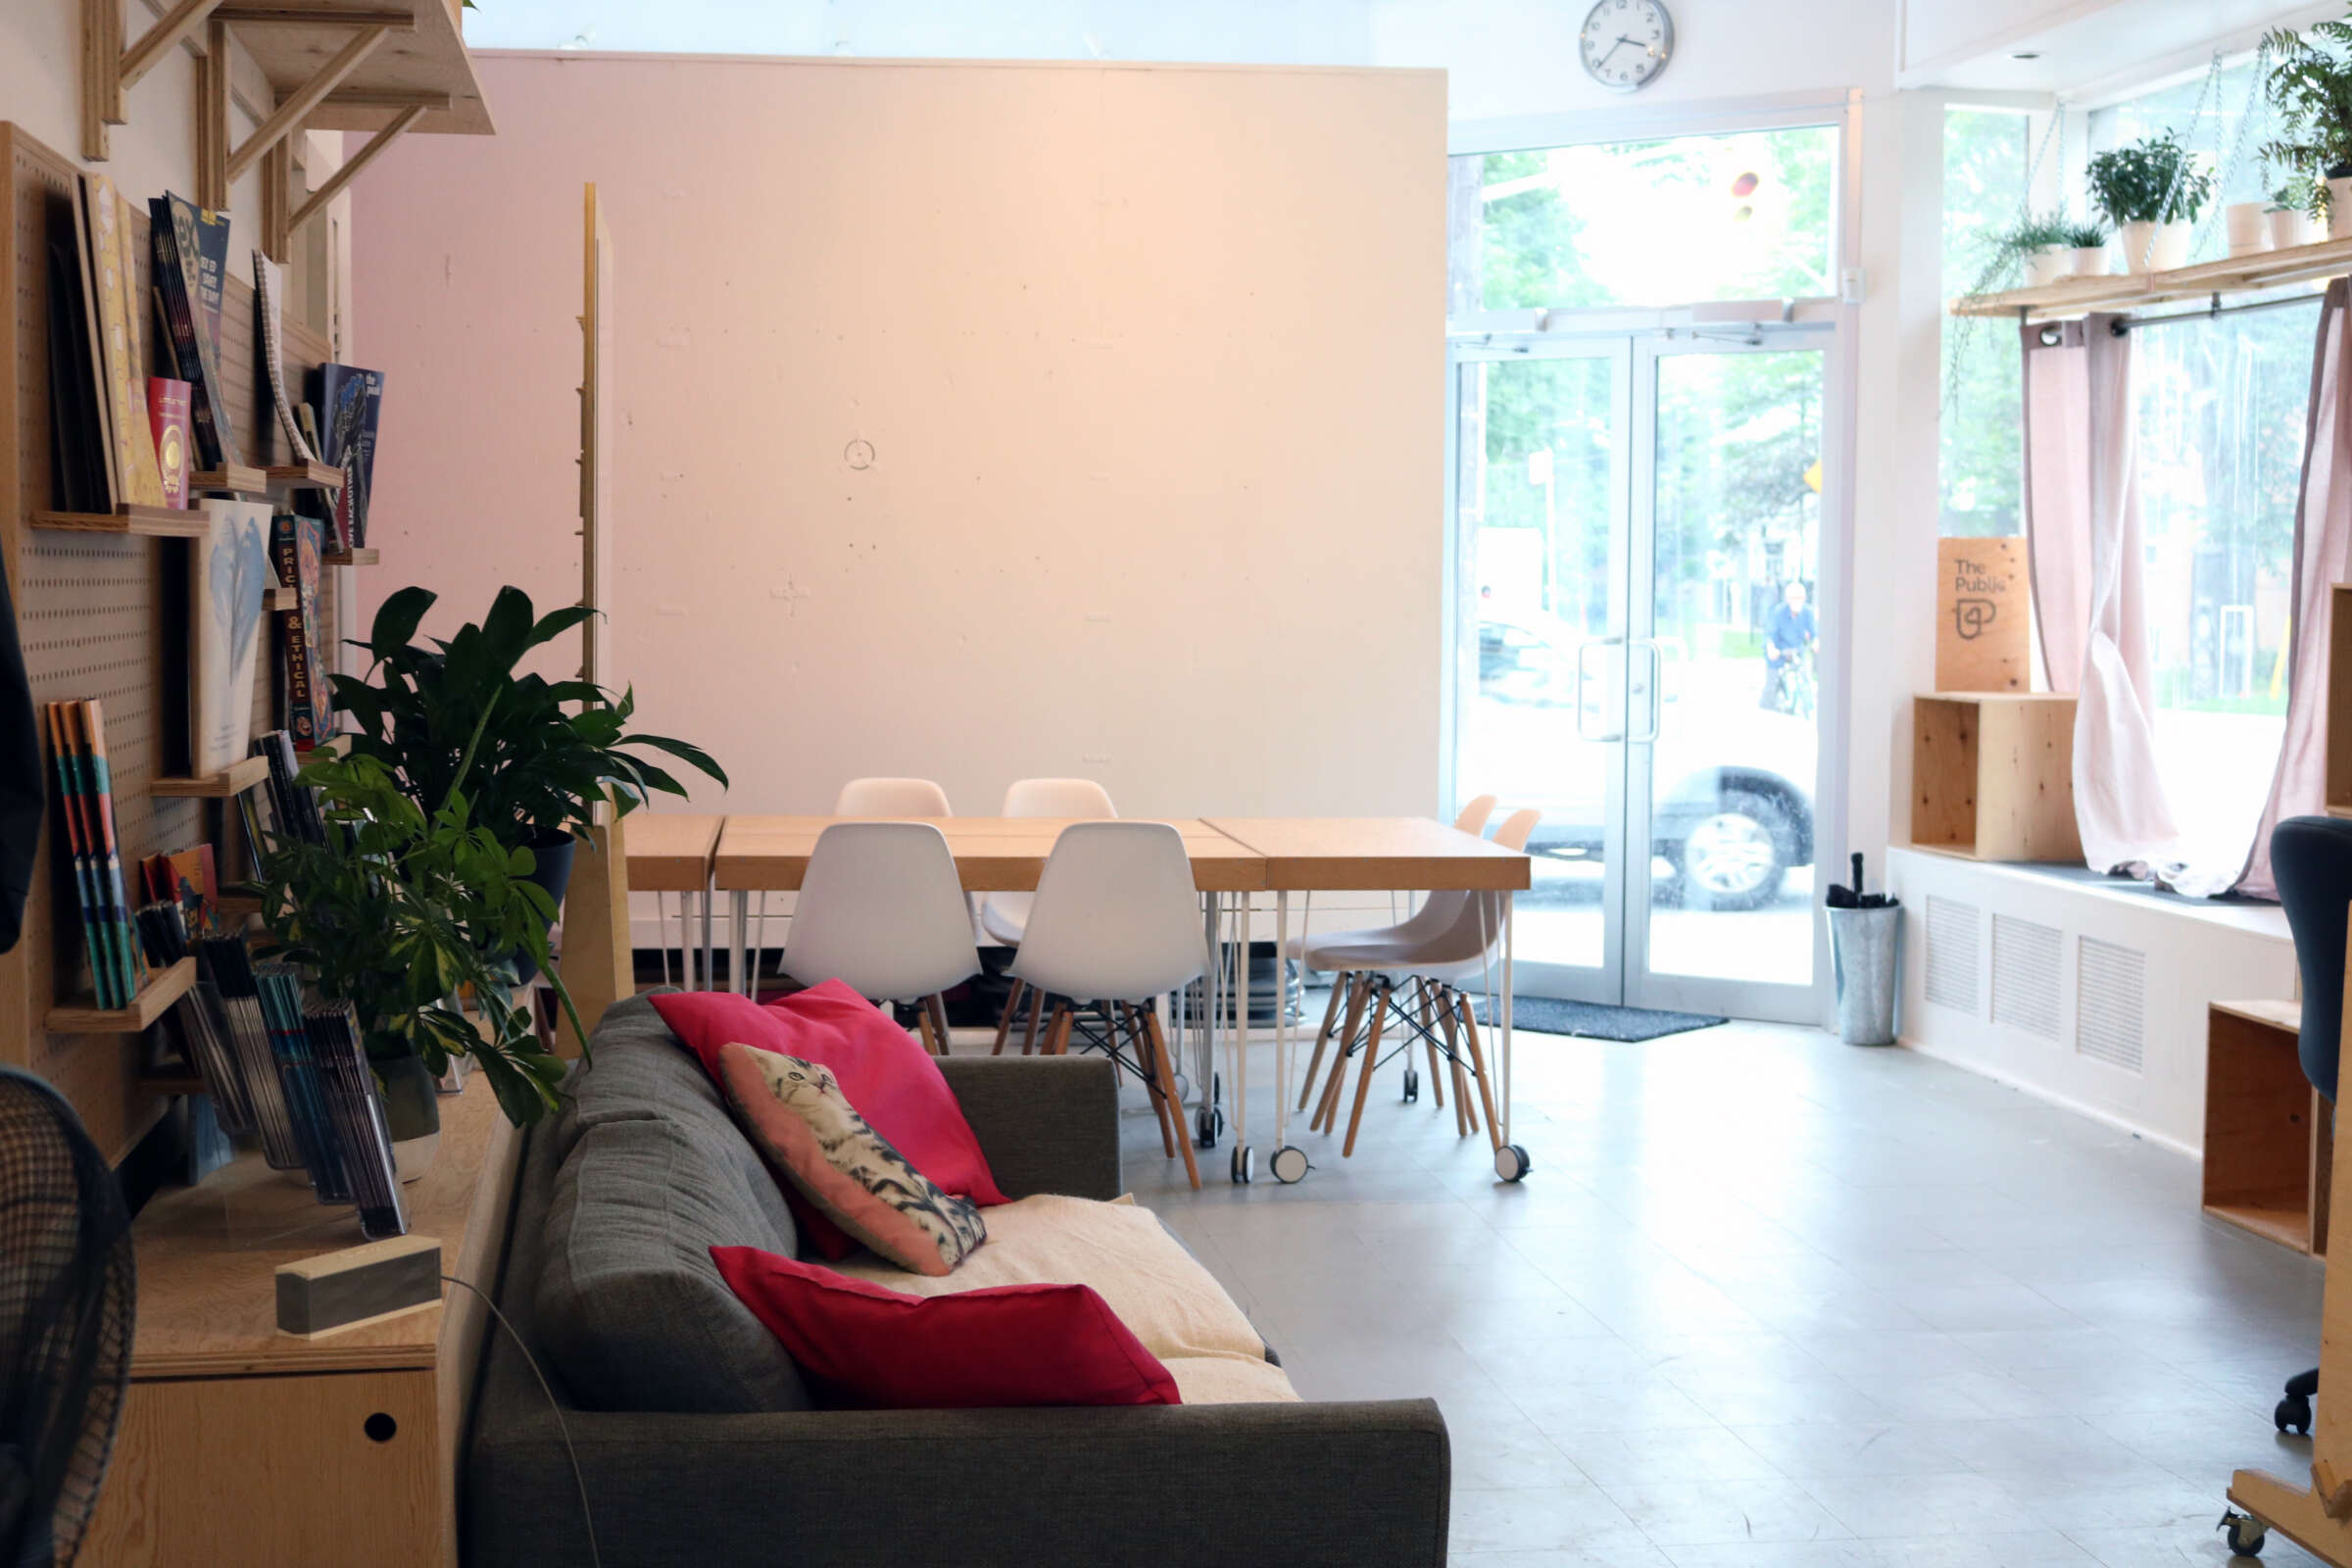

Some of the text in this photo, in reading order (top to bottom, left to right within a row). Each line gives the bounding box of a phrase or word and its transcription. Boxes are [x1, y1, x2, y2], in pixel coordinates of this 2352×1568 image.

[1953, 559, 1985, 574] The
[288, 615, 303, 630] &
[292, 635, 306, 698] ETHICAL
